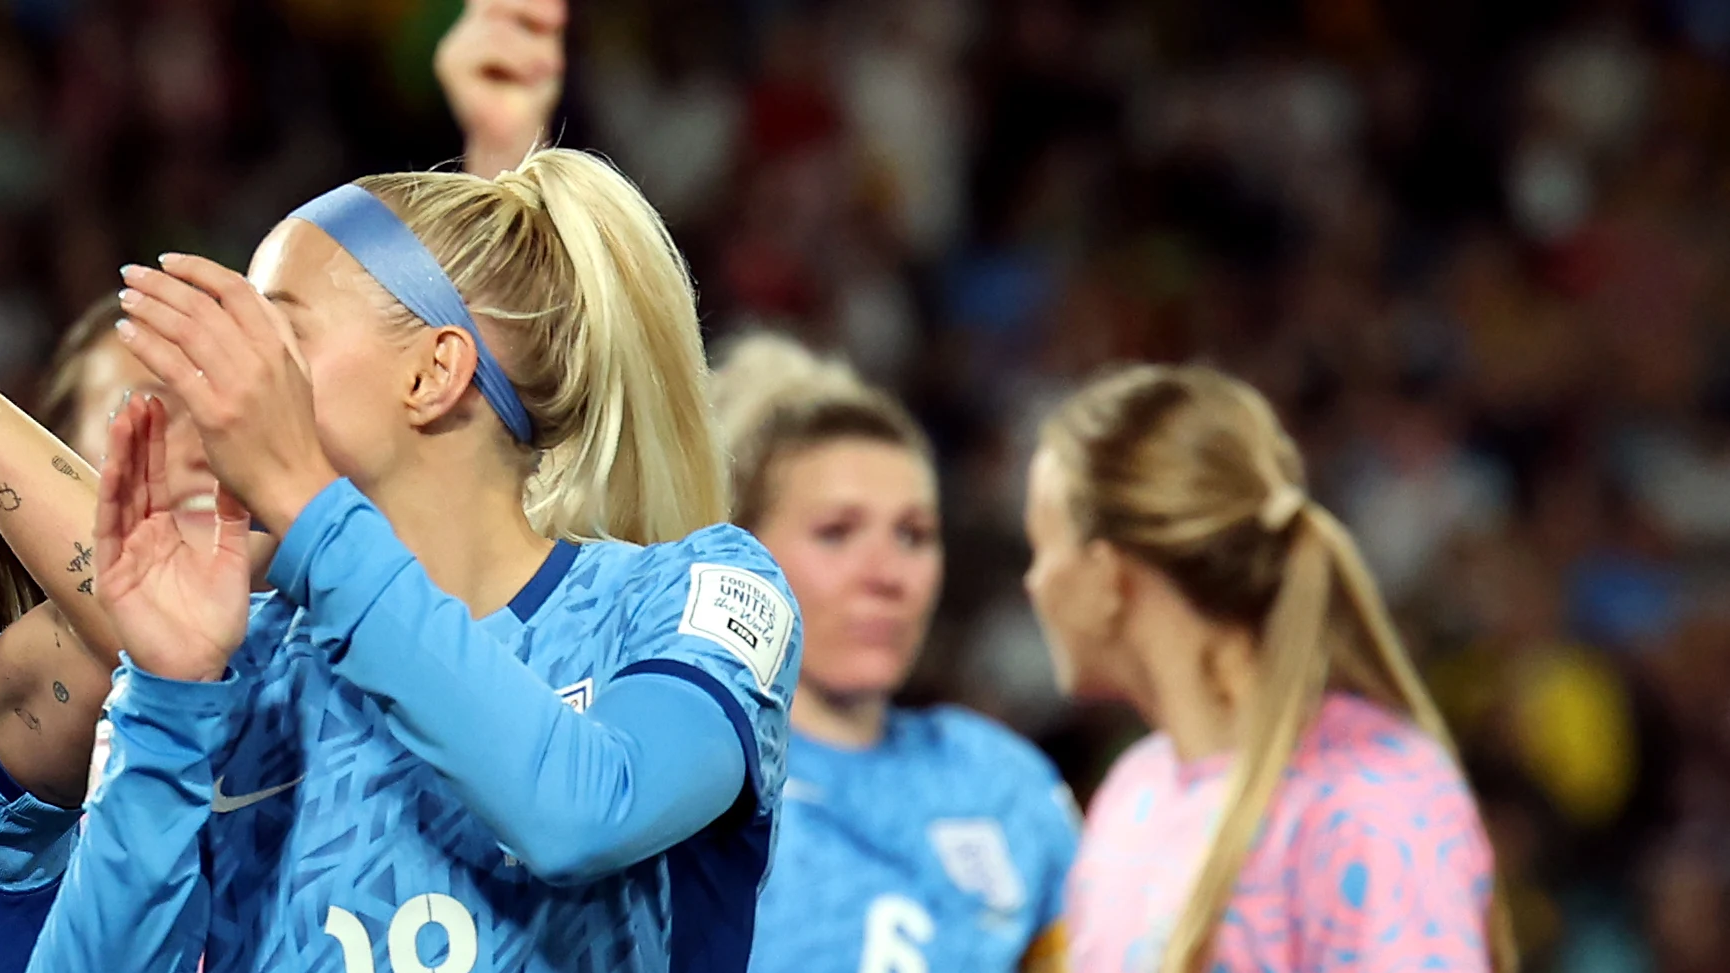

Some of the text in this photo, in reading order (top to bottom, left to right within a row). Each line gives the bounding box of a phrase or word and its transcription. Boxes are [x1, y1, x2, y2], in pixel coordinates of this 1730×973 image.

[714, 597, 737, 614] the
[720, 575, 776, 616] FOOTBALL
[720, 584, 776, 630] UNITES
